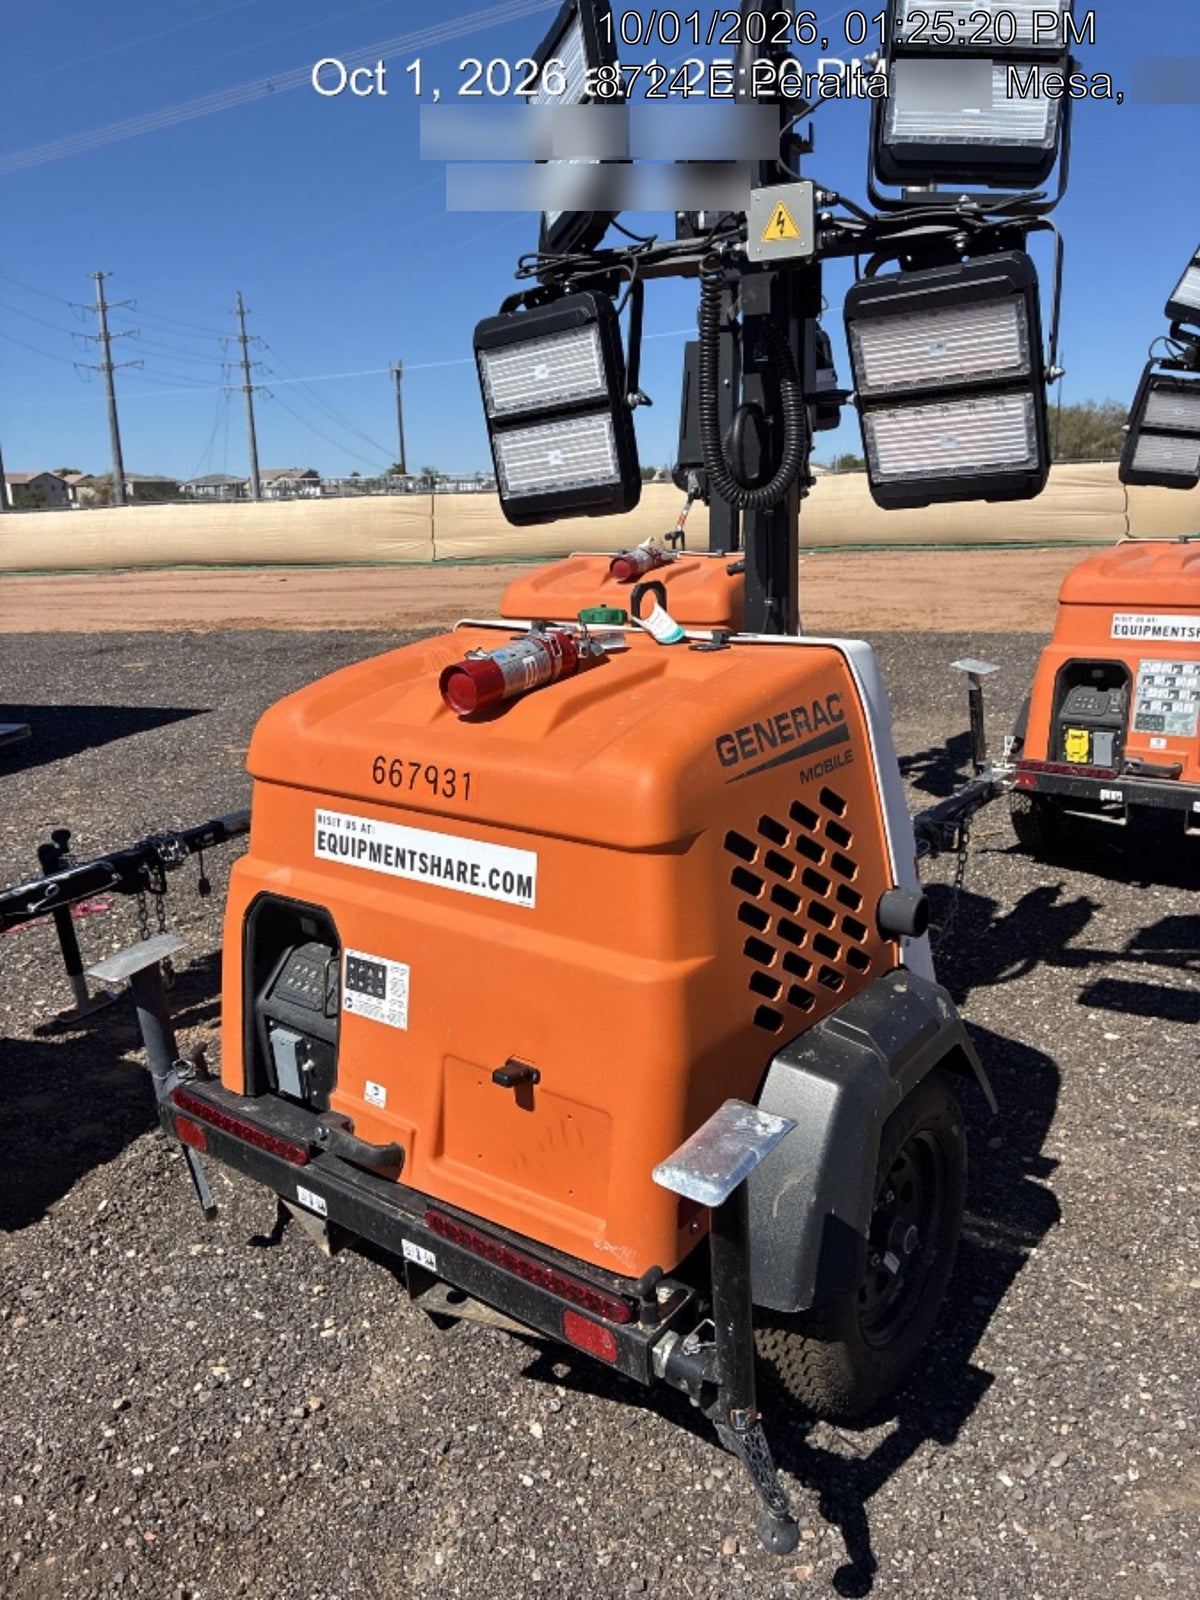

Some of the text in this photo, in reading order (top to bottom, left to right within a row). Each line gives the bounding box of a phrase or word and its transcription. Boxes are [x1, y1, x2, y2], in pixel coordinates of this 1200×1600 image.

[715, 692, 845, 767] GENERAC
[372, 754, 471, 802] 667931
[799, 748, 855, 785] MOBILE
[316, 828, 533, 900] EQUIPMENTSHARE.COM
